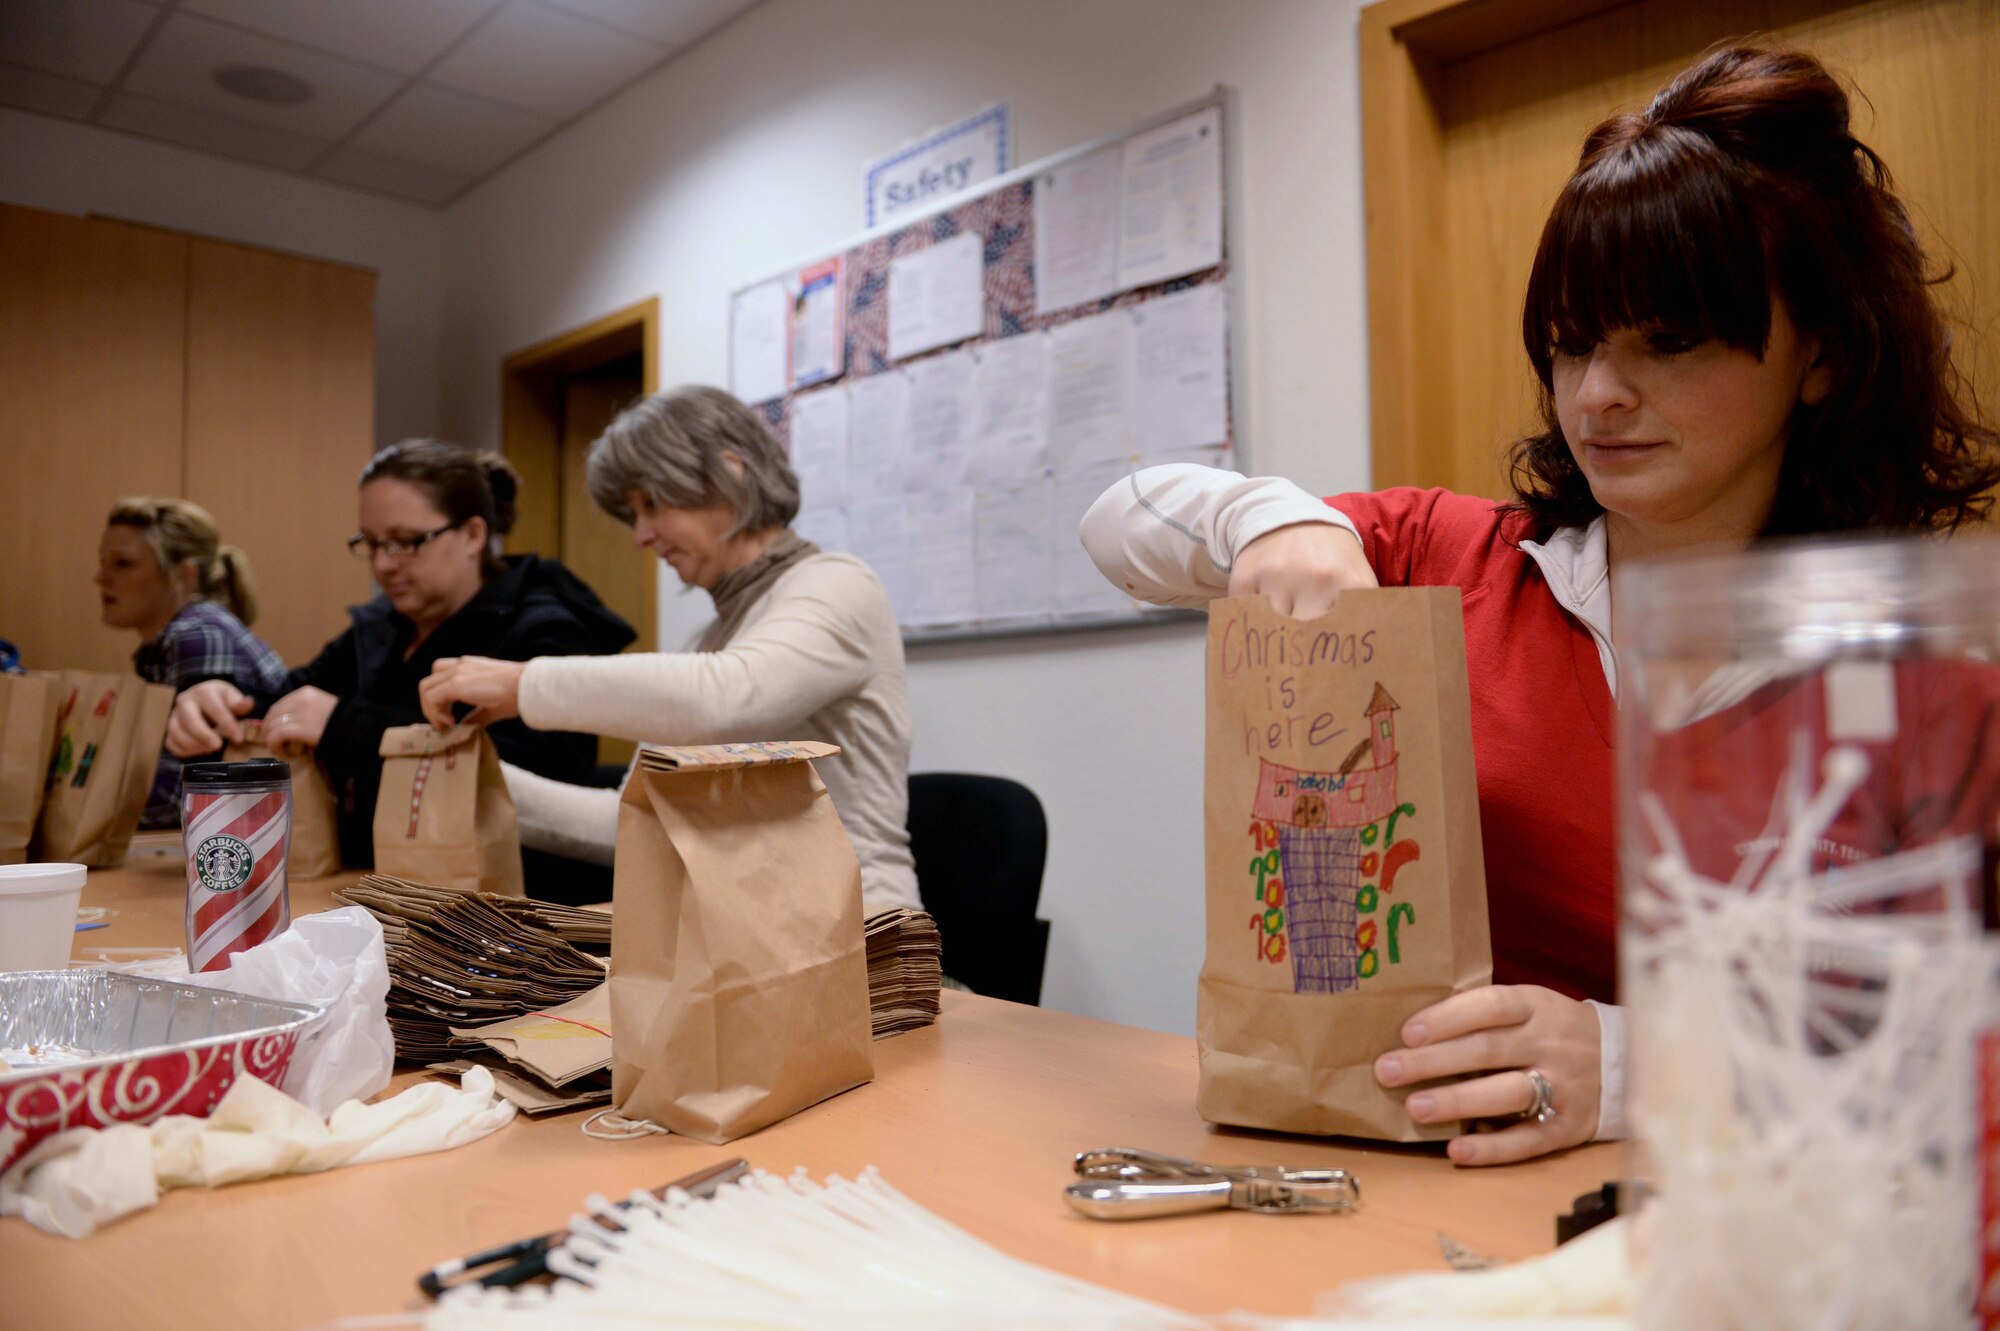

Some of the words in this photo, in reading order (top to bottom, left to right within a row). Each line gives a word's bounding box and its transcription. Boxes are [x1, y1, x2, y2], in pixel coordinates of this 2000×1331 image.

[885, 155, 974, 212] Safety
[1221, 611, 1377, 680] Chrismas
[1265, 675, 1296, 711] is
[1242, 710, 1349, 756] here
[197, 838, 250, 861] STARBUCKS
[203, 874, 243, 890] COFFEE
